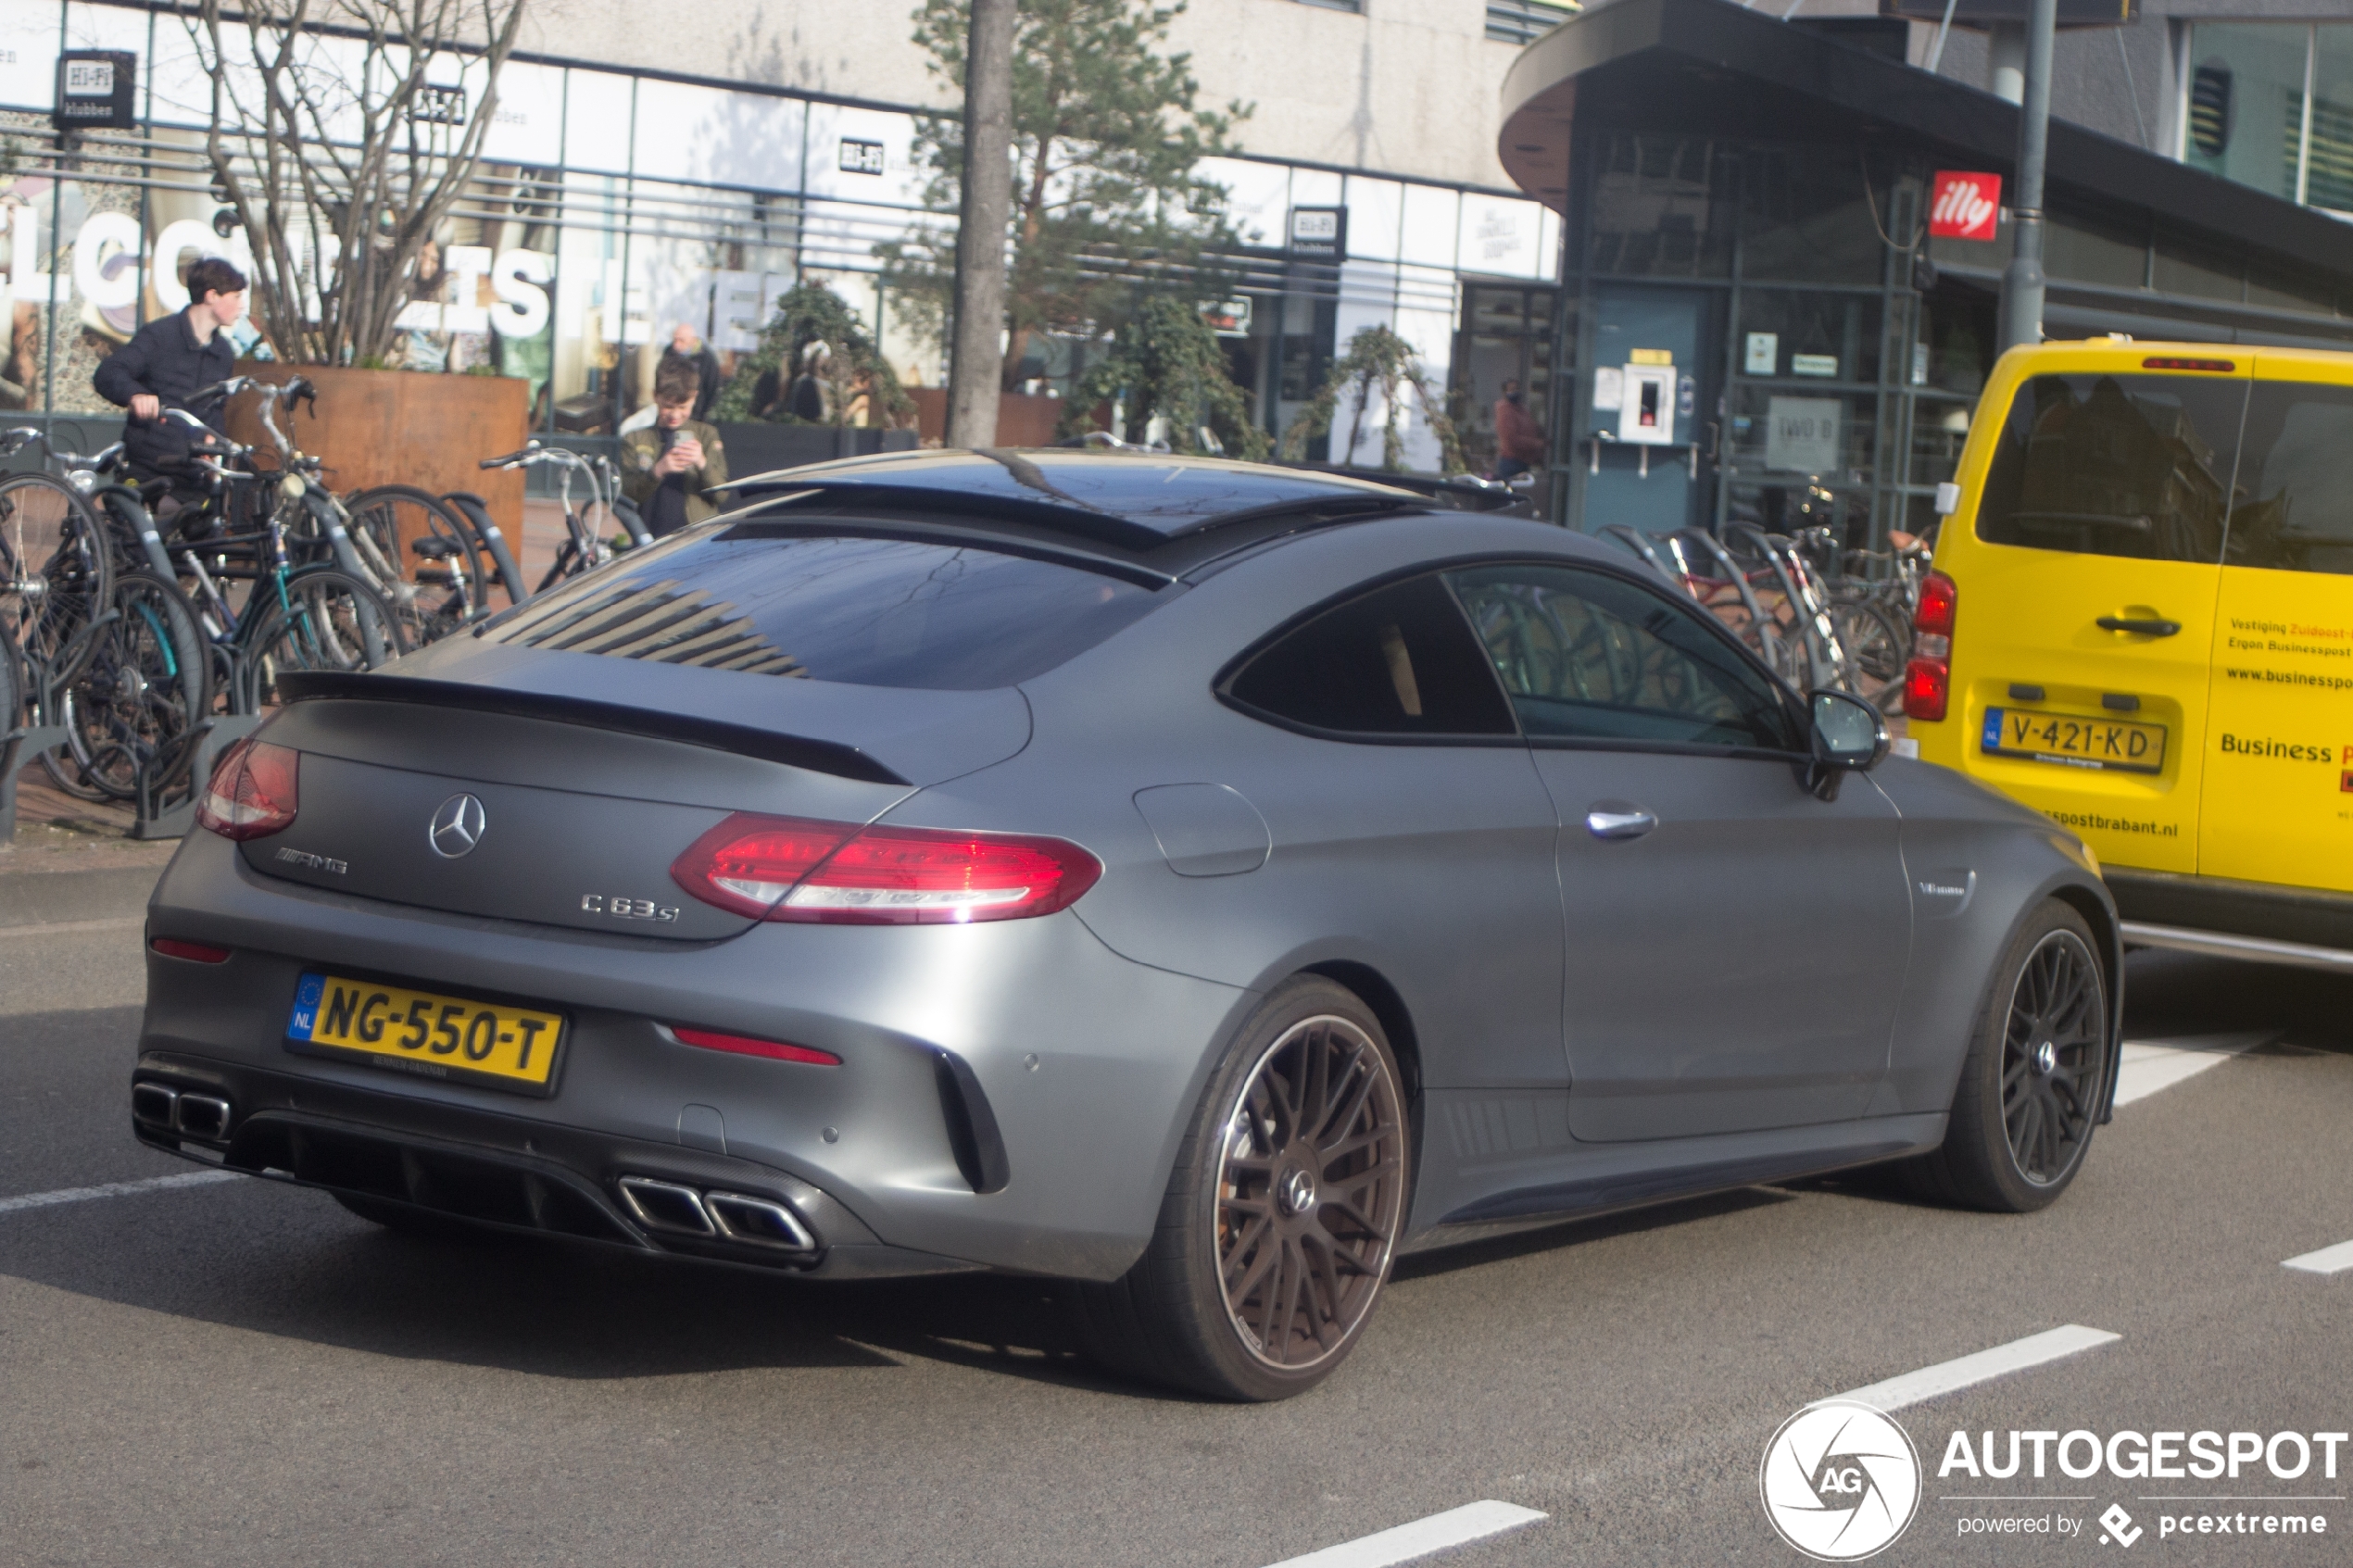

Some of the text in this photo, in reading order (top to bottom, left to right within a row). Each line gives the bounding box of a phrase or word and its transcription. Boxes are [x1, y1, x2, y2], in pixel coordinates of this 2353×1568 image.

[70, 67, 110, 86] Hi-Fi
[64, 101, 113, 117] klubben
[1933, 180, 1994, 236] illy
[2230, 618, 2286, 634] Vestiging
[2228, 636, 2351, 657] Ergon Businesspost
[2013, 716, 2148, 758] V-421-KD
[2221, 733, 2332, 762] Business
[296, 850, 347, 874] AMG
[581, 893, 602, 913] C
[294, 985, 548, 1070] NL NG-550-T
